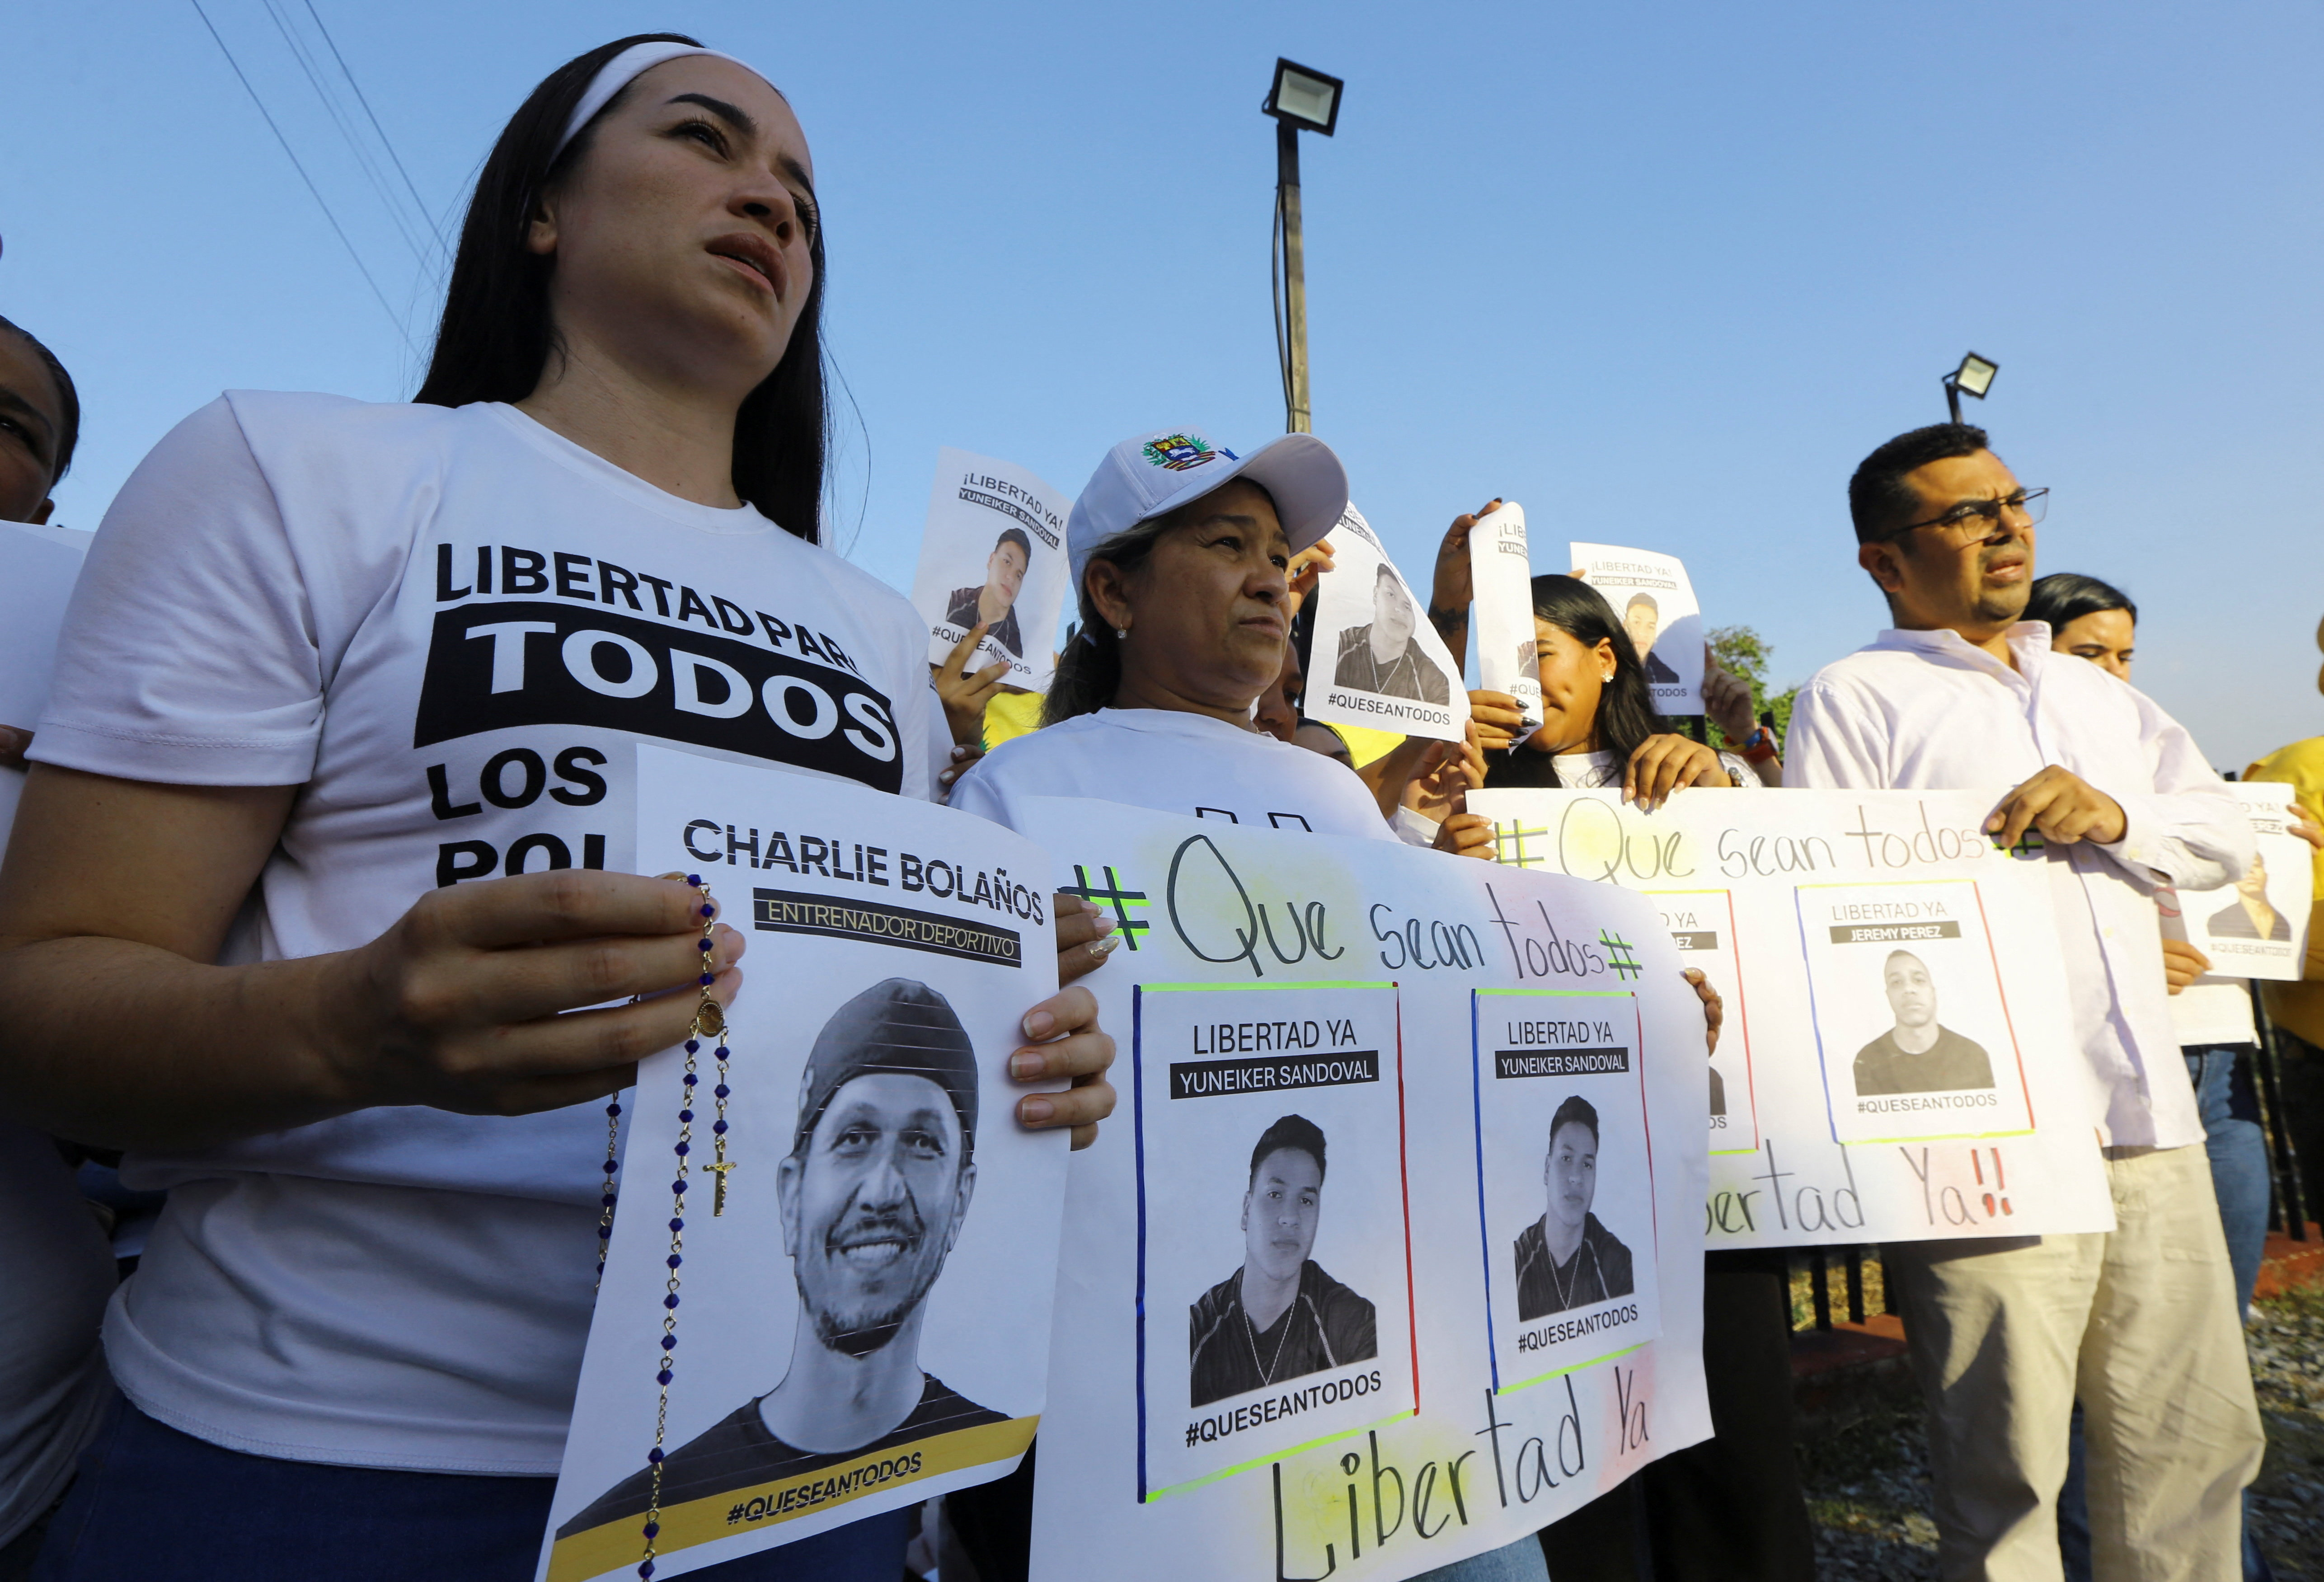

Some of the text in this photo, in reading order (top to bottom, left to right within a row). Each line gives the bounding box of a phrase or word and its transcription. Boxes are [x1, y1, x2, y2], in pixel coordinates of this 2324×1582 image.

[959, 488, 1059, 548] YUNEIKER SANDOVAL
[1045, 508, 1063, 531] YA!
[437, 543, 755, 636] LIBERTAD
[1592, 577, 1676, 588] YUNEIKER SANDOVAL
[465, 620, 895, 762] TODOS
[1328, 693, 1450, 725] #QUESEANTODOS
[427, 746, 608, 820] LOS
[684, 819, 1044, 926] CHARLIE BOLAÑOS
[768, 900, 1014, 957] ENTRENADOR DEPORTIVO
[1675, 912, 1698, 928] YA
[1832, 901, 1948, 921] LIBERTAD YA
[1851, 926, 1943, 942] JEREMY PEREZ
[1194, 1019, 1357, 1055] LIBERTAD YA
[1508, 1022, 1614, 1045] LIBERTAD YA
[1180, 1060, 1372, 1094] YUNEIKER SANDOVAL
[1501, 1054, 1625, 1075] YUNEIKER SANDOVAL
[1857, 1094, 1997, 1113] #QUESEANTODOS
[1518, 1304, 1638, 1353] #QUESEANTODOS
[1185, 1371, 1381, 1448] #QUESEANTODOS
[726, 1451, 922, 1525] #QUESEANTODOS
